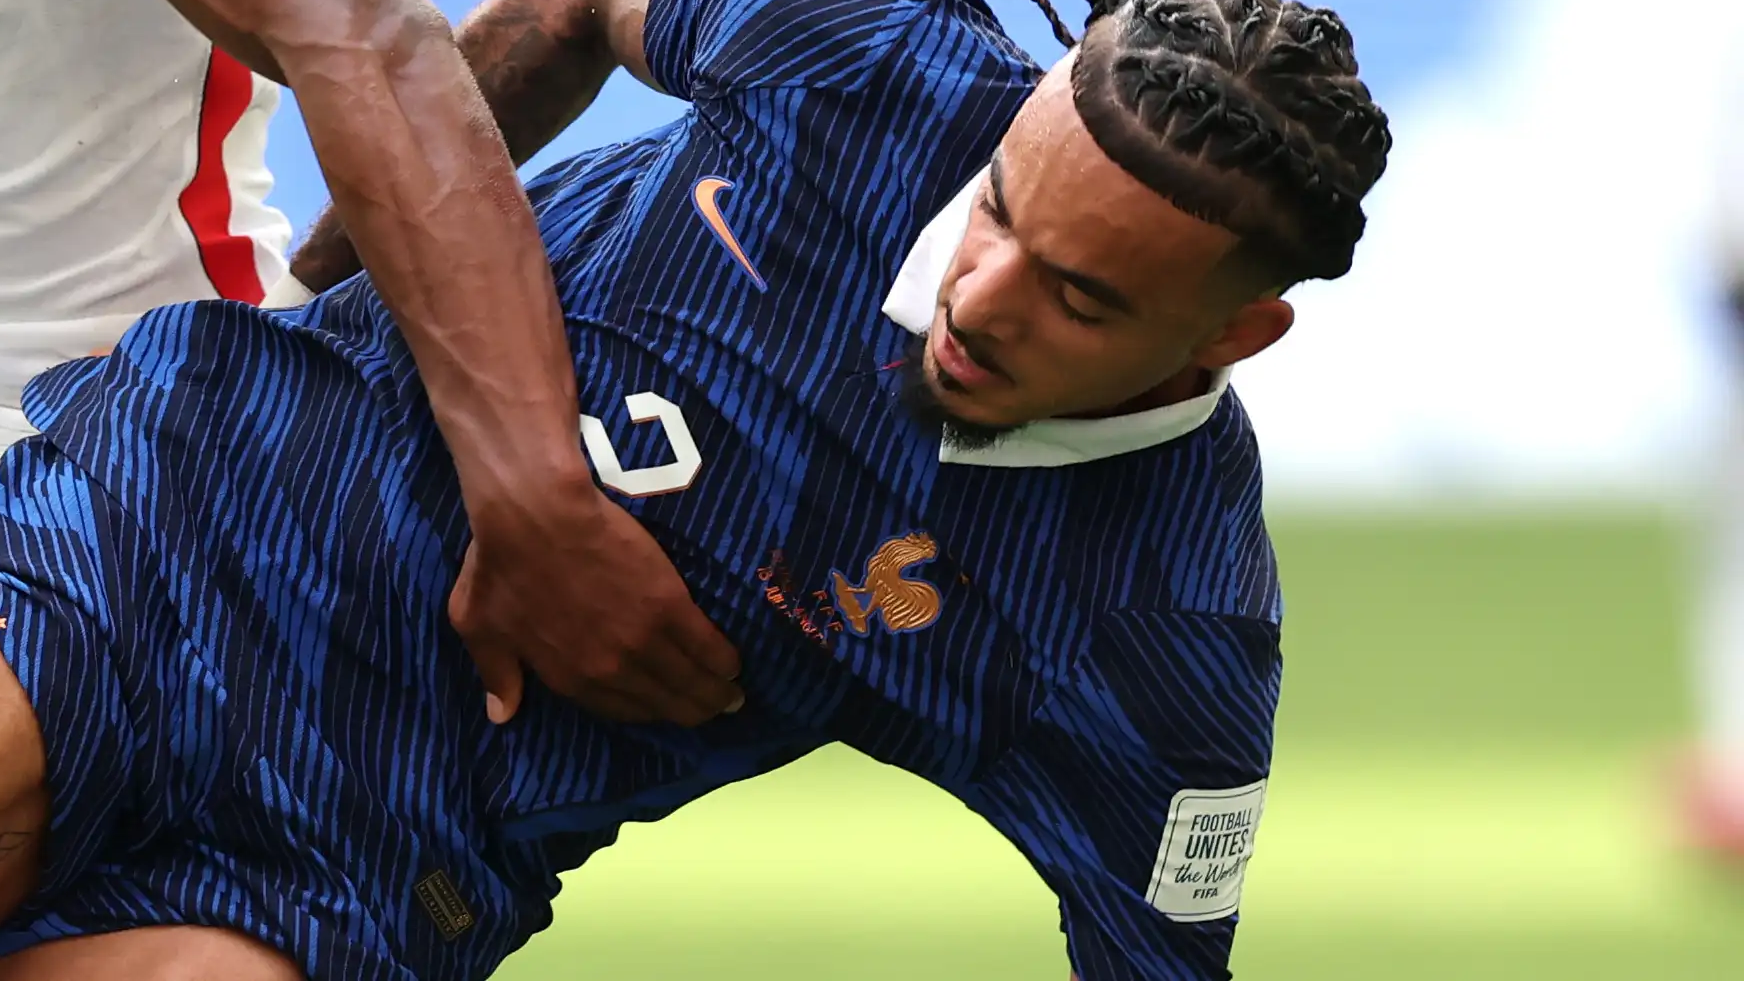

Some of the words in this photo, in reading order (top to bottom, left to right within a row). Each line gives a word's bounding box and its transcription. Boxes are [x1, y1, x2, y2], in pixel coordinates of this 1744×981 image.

[1191, 807, 1253, 833] FOOTBALL
[1185, 828, 1249, 859] UNITES
[1174, 862, 1203, 884] the
[1192, 887, 1219, 899] FIFA
